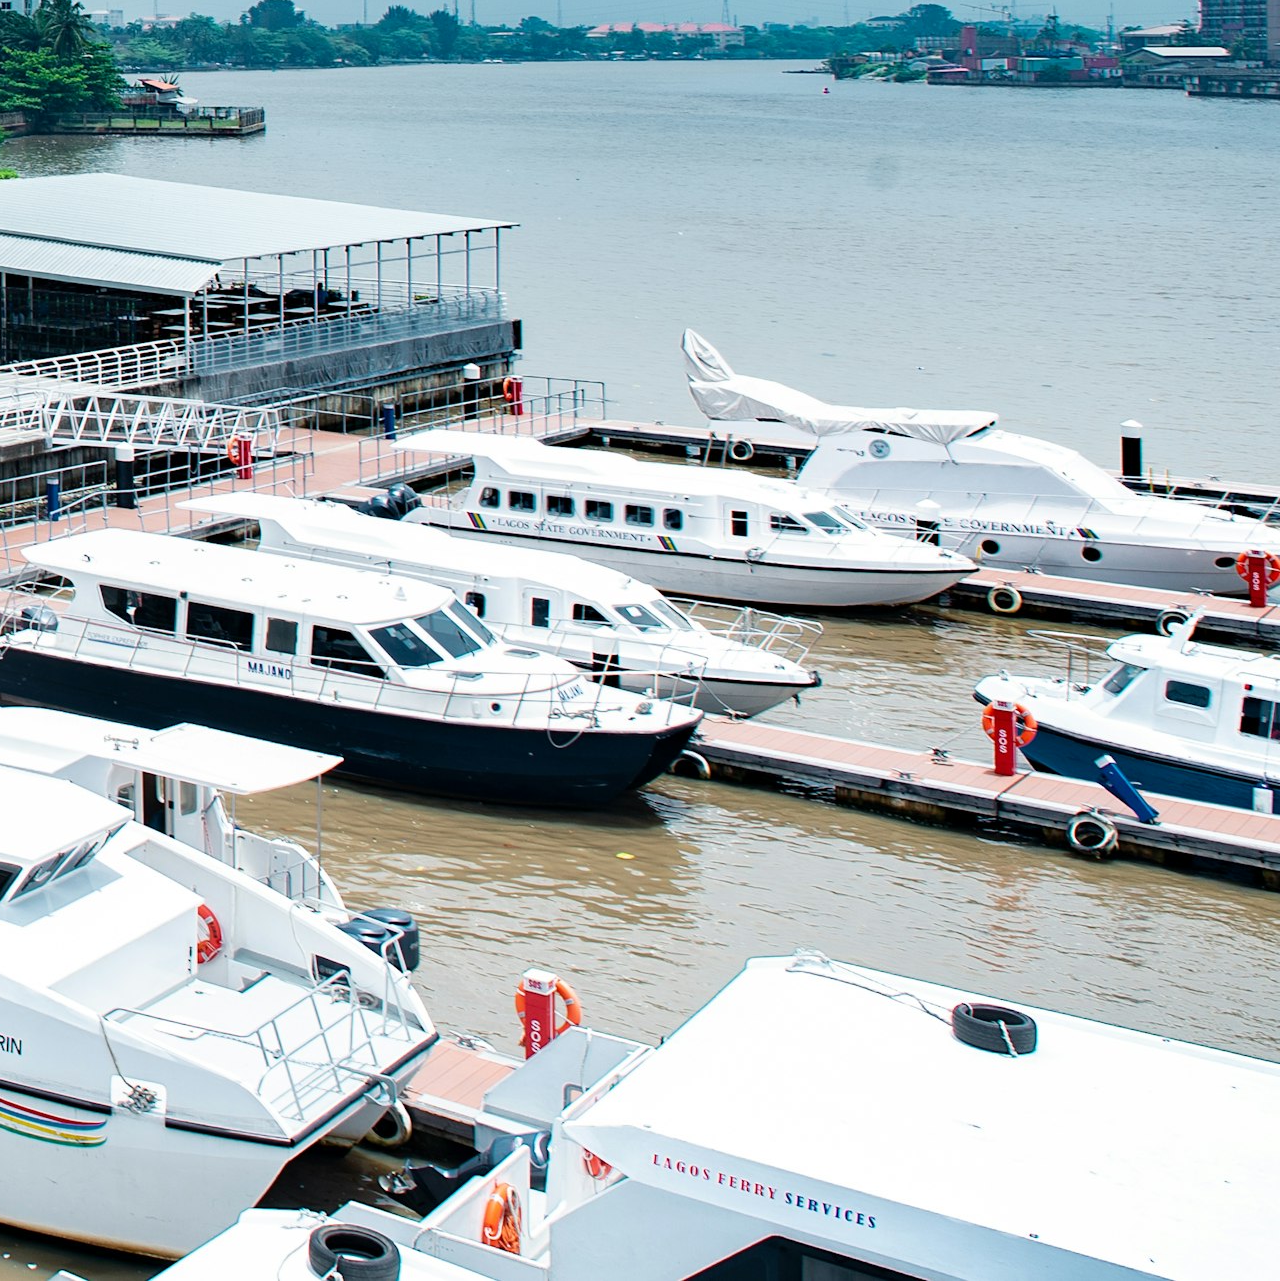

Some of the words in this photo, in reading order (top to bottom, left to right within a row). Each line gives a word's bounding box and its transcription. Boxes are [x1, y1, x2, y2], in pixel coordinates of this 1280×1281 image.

[497, 517, 530, 530] LAGOS
[534, 522, 565, 534] STATE
[568, 526, 646, 543] GOVERNMENT
[1252, 571, 1260, 591] SOS
[998, 729, 1008, 754] SOS
[530, 1019, 542, 1053] SOS
[652, 1153, 712, 1181] LAGOS
[716, 1172, 778, 1200] FERRY
[784, 1191, 878, 1230] SERVICES
